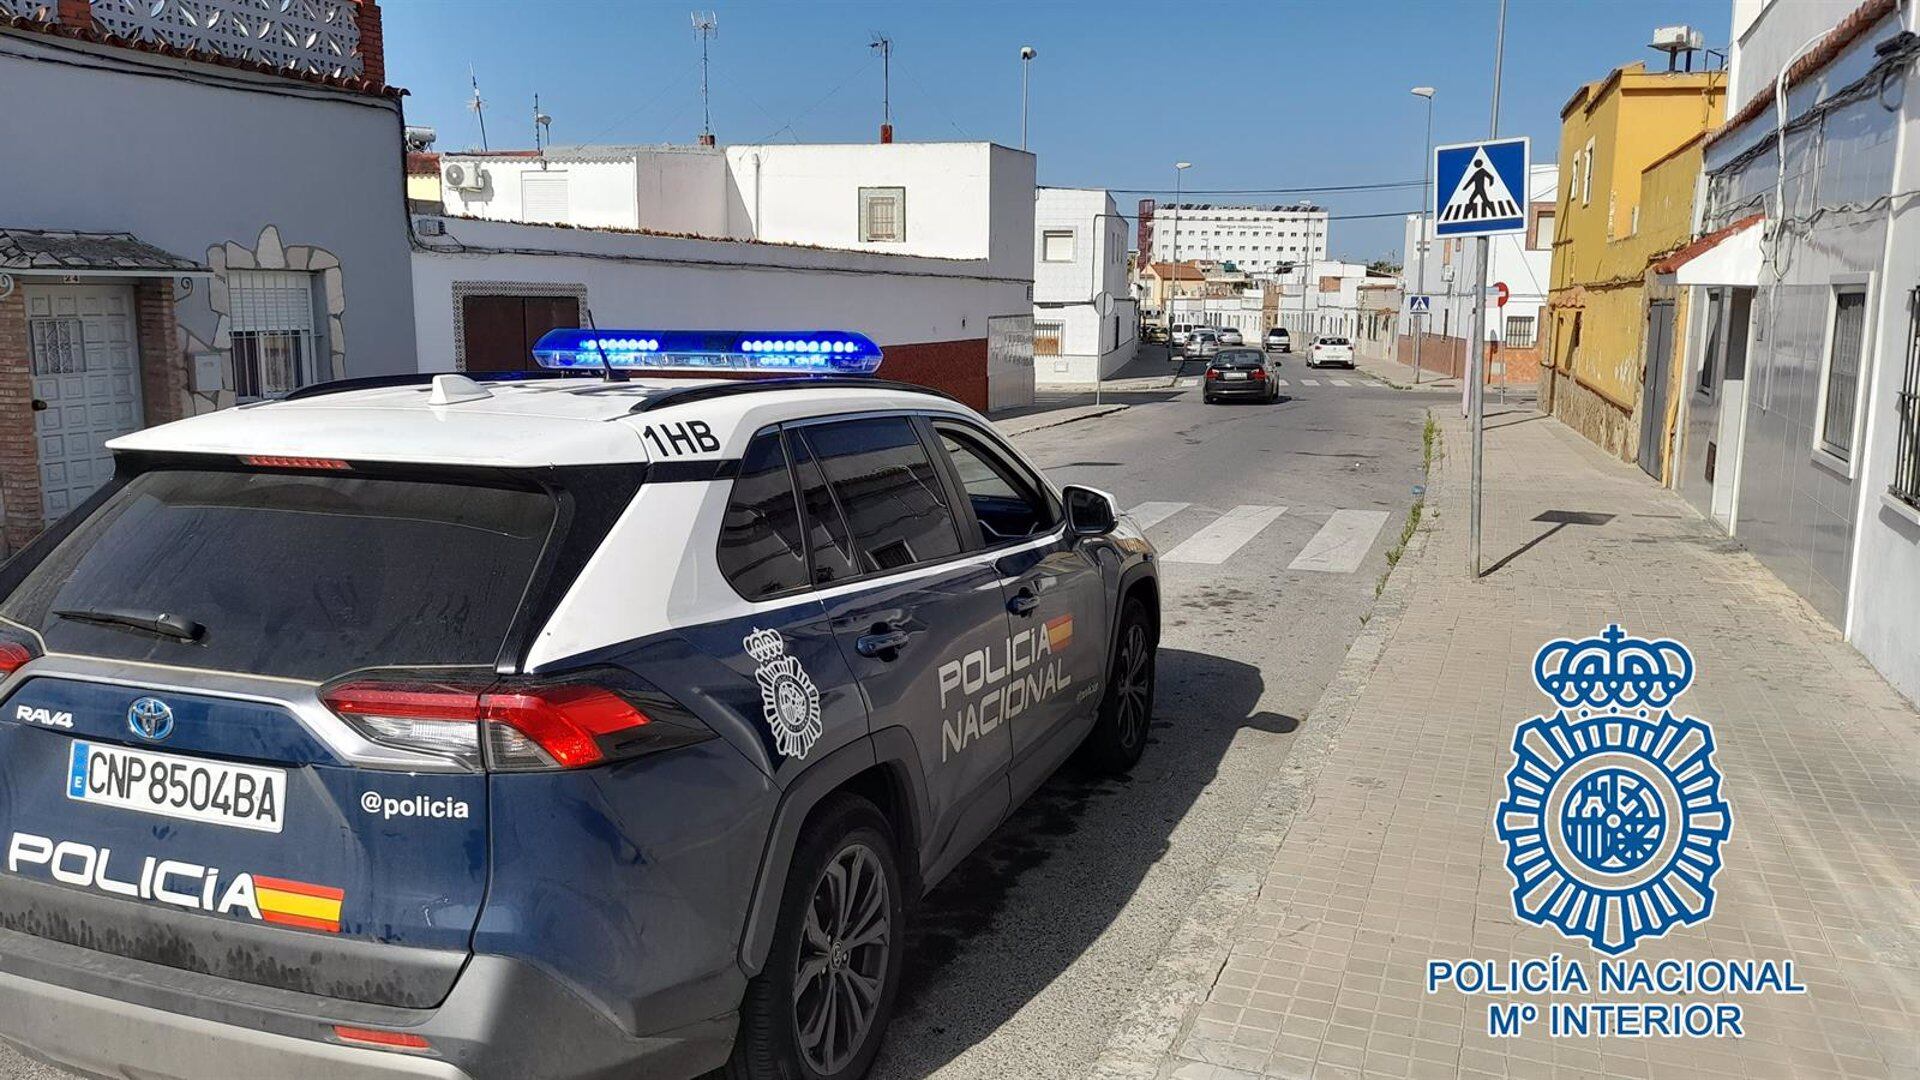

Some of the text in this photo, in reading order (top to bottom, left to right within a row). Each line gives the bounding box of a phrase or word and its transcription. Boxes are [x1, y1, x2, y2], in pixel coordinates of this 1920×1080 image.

[643, 420, 721, 457] 1HB
[16, 705, 74, 728] RAV4
[941, 657, 1072, 764] NACIONAL
[73, 776, 83, 789] E
[360, 791, 469, 819] @policia
